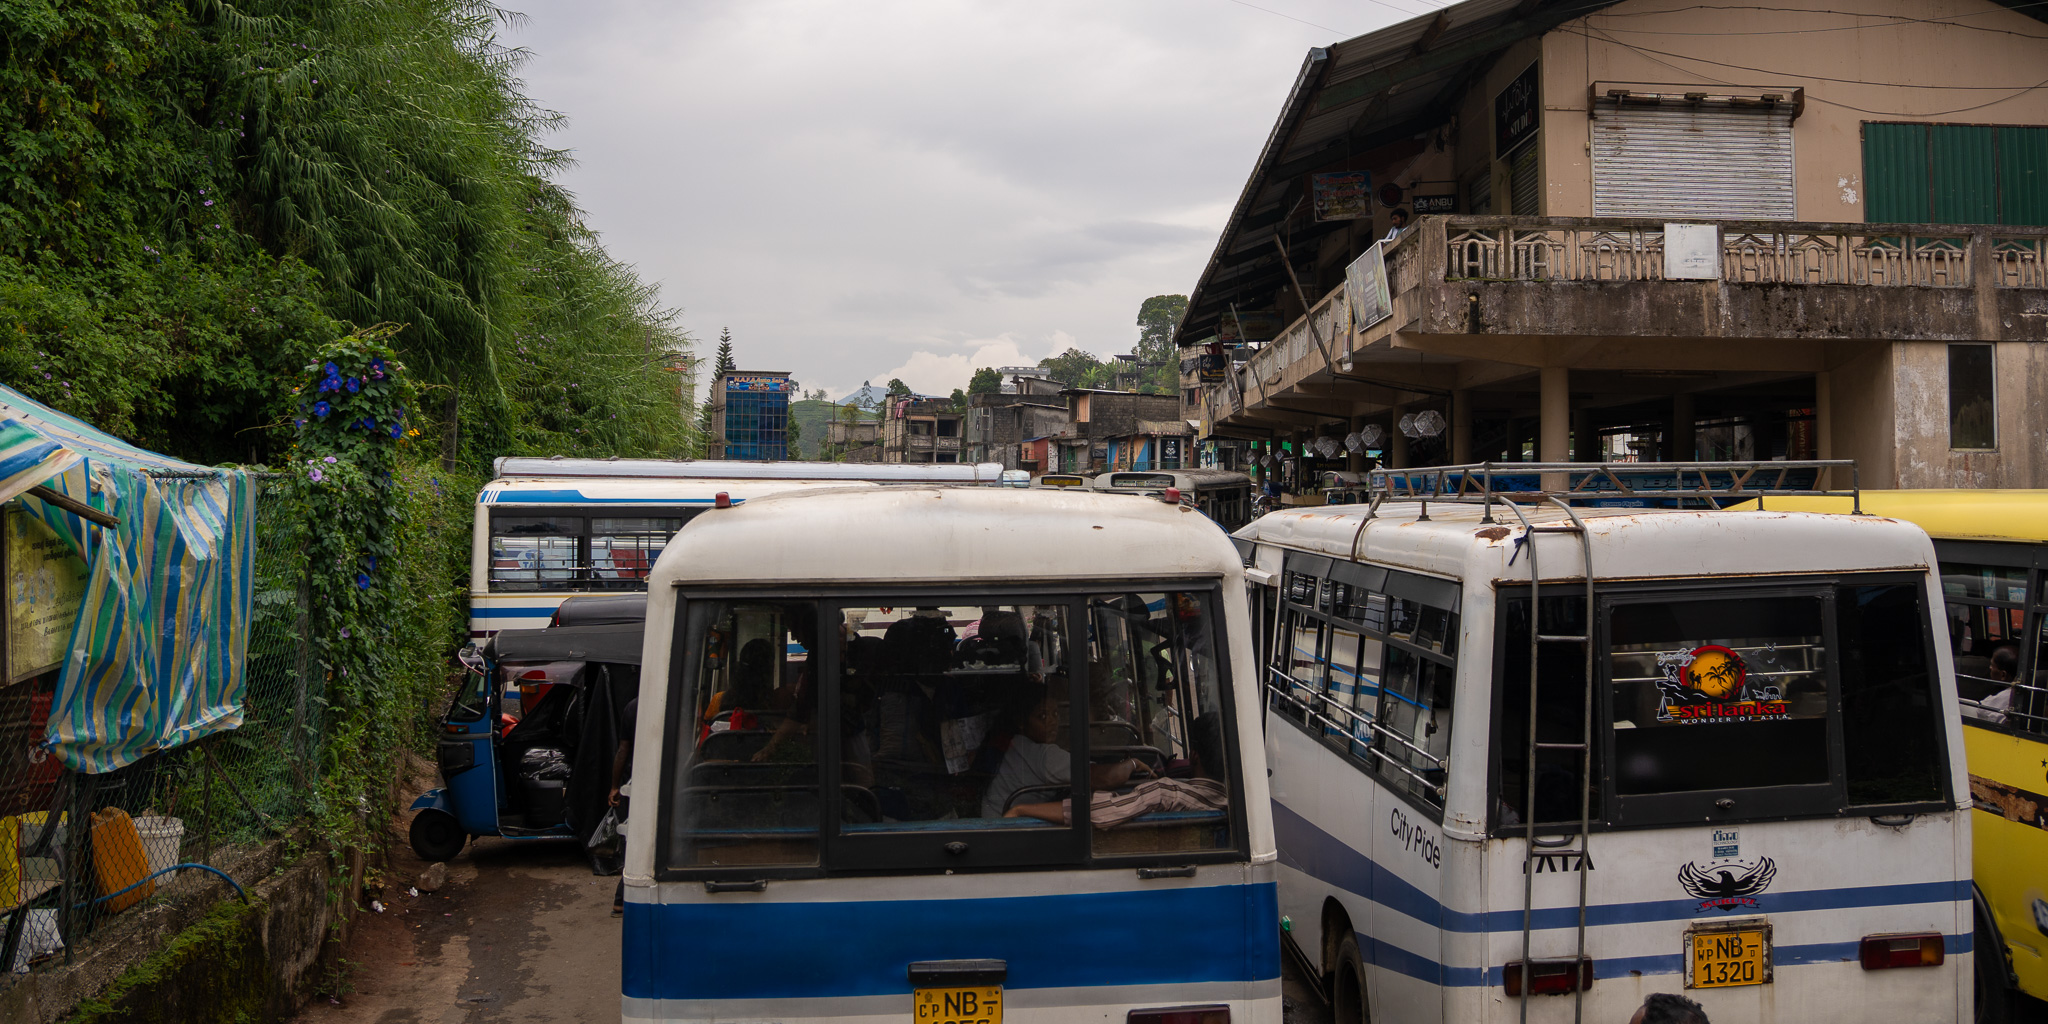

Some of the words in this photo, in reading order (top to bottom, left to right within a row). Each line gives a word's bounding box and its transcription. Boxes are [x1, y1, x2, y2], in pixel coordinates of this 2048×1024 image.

[1429, 197, 1453, 206] ANBU
[1717, 701, 1786, 717] lanka
[1681, 717, 1732, 725] WONDER
[1391, 808, 1413, 851] City
[1523, 850, 1595, 874] ATA
[1698, 949, 1713, 961] WP
[1703, 960, 1754, 984] 1320
